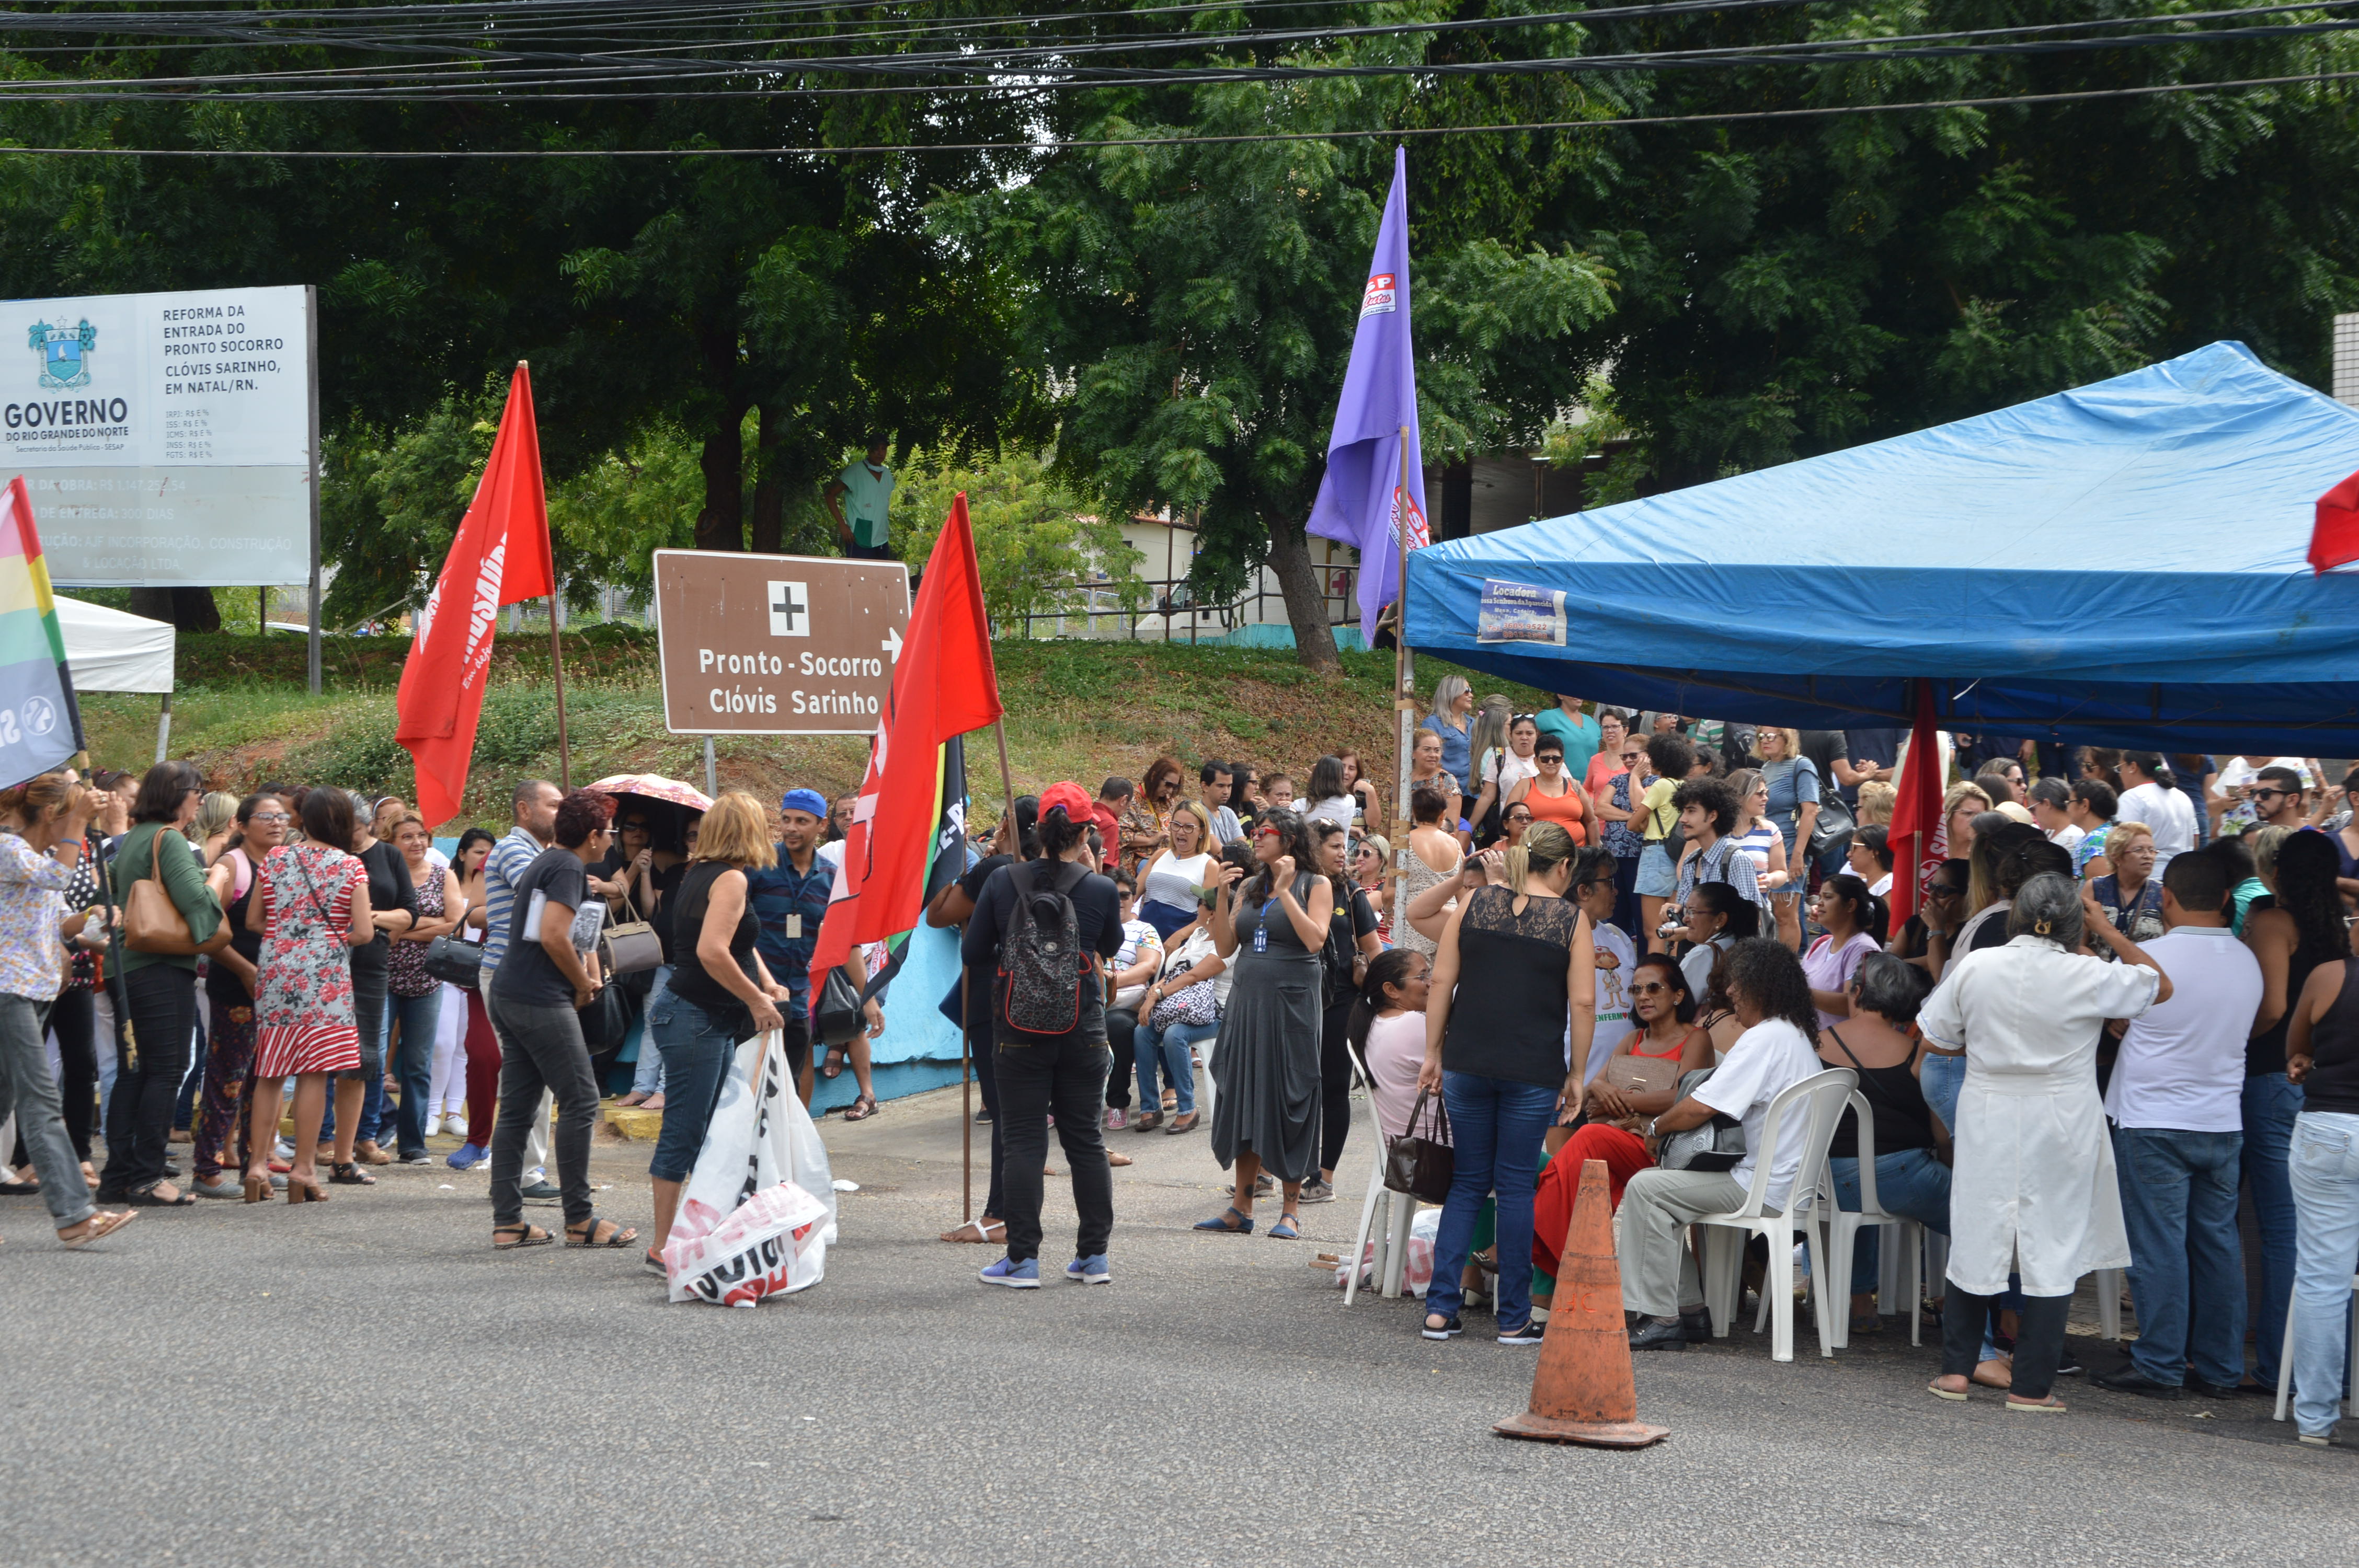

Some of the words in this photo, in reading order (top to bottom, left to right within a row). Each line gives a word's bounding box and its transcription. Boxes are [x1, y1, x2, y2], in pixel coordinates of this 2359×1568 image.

[163, 306, 223, 321] REFORMA
[228, 305, 245, 317] DA
[164, 324, 223, 339] ENTRADA
[227, 322, 245, 335] DO
[165, 342, 216, 356] PRONTO
[221, 338, 283, 352] SOCORRO
[166, 361, 211, 377] CLÓVIS
[216, 360, 281, 374] SARINHO,
[166, 383, 182, 395] EM
[188, 379, 258, 394] NATAL/RN.
[5, 397, 128, 428] GOVERNO
[6, 432, 20, 441] DO
[22, 431, 38, 441] RIO
[41, 429, 80, 440] GRANDE
[83, 429, 95, 437] DO
[97, 426, 129, 437] NORTE
[800, 652, 882, 676] Socorro
[709, 685, 777, 713] Clóvis
[791, 689, 879, 714] Sarinho
